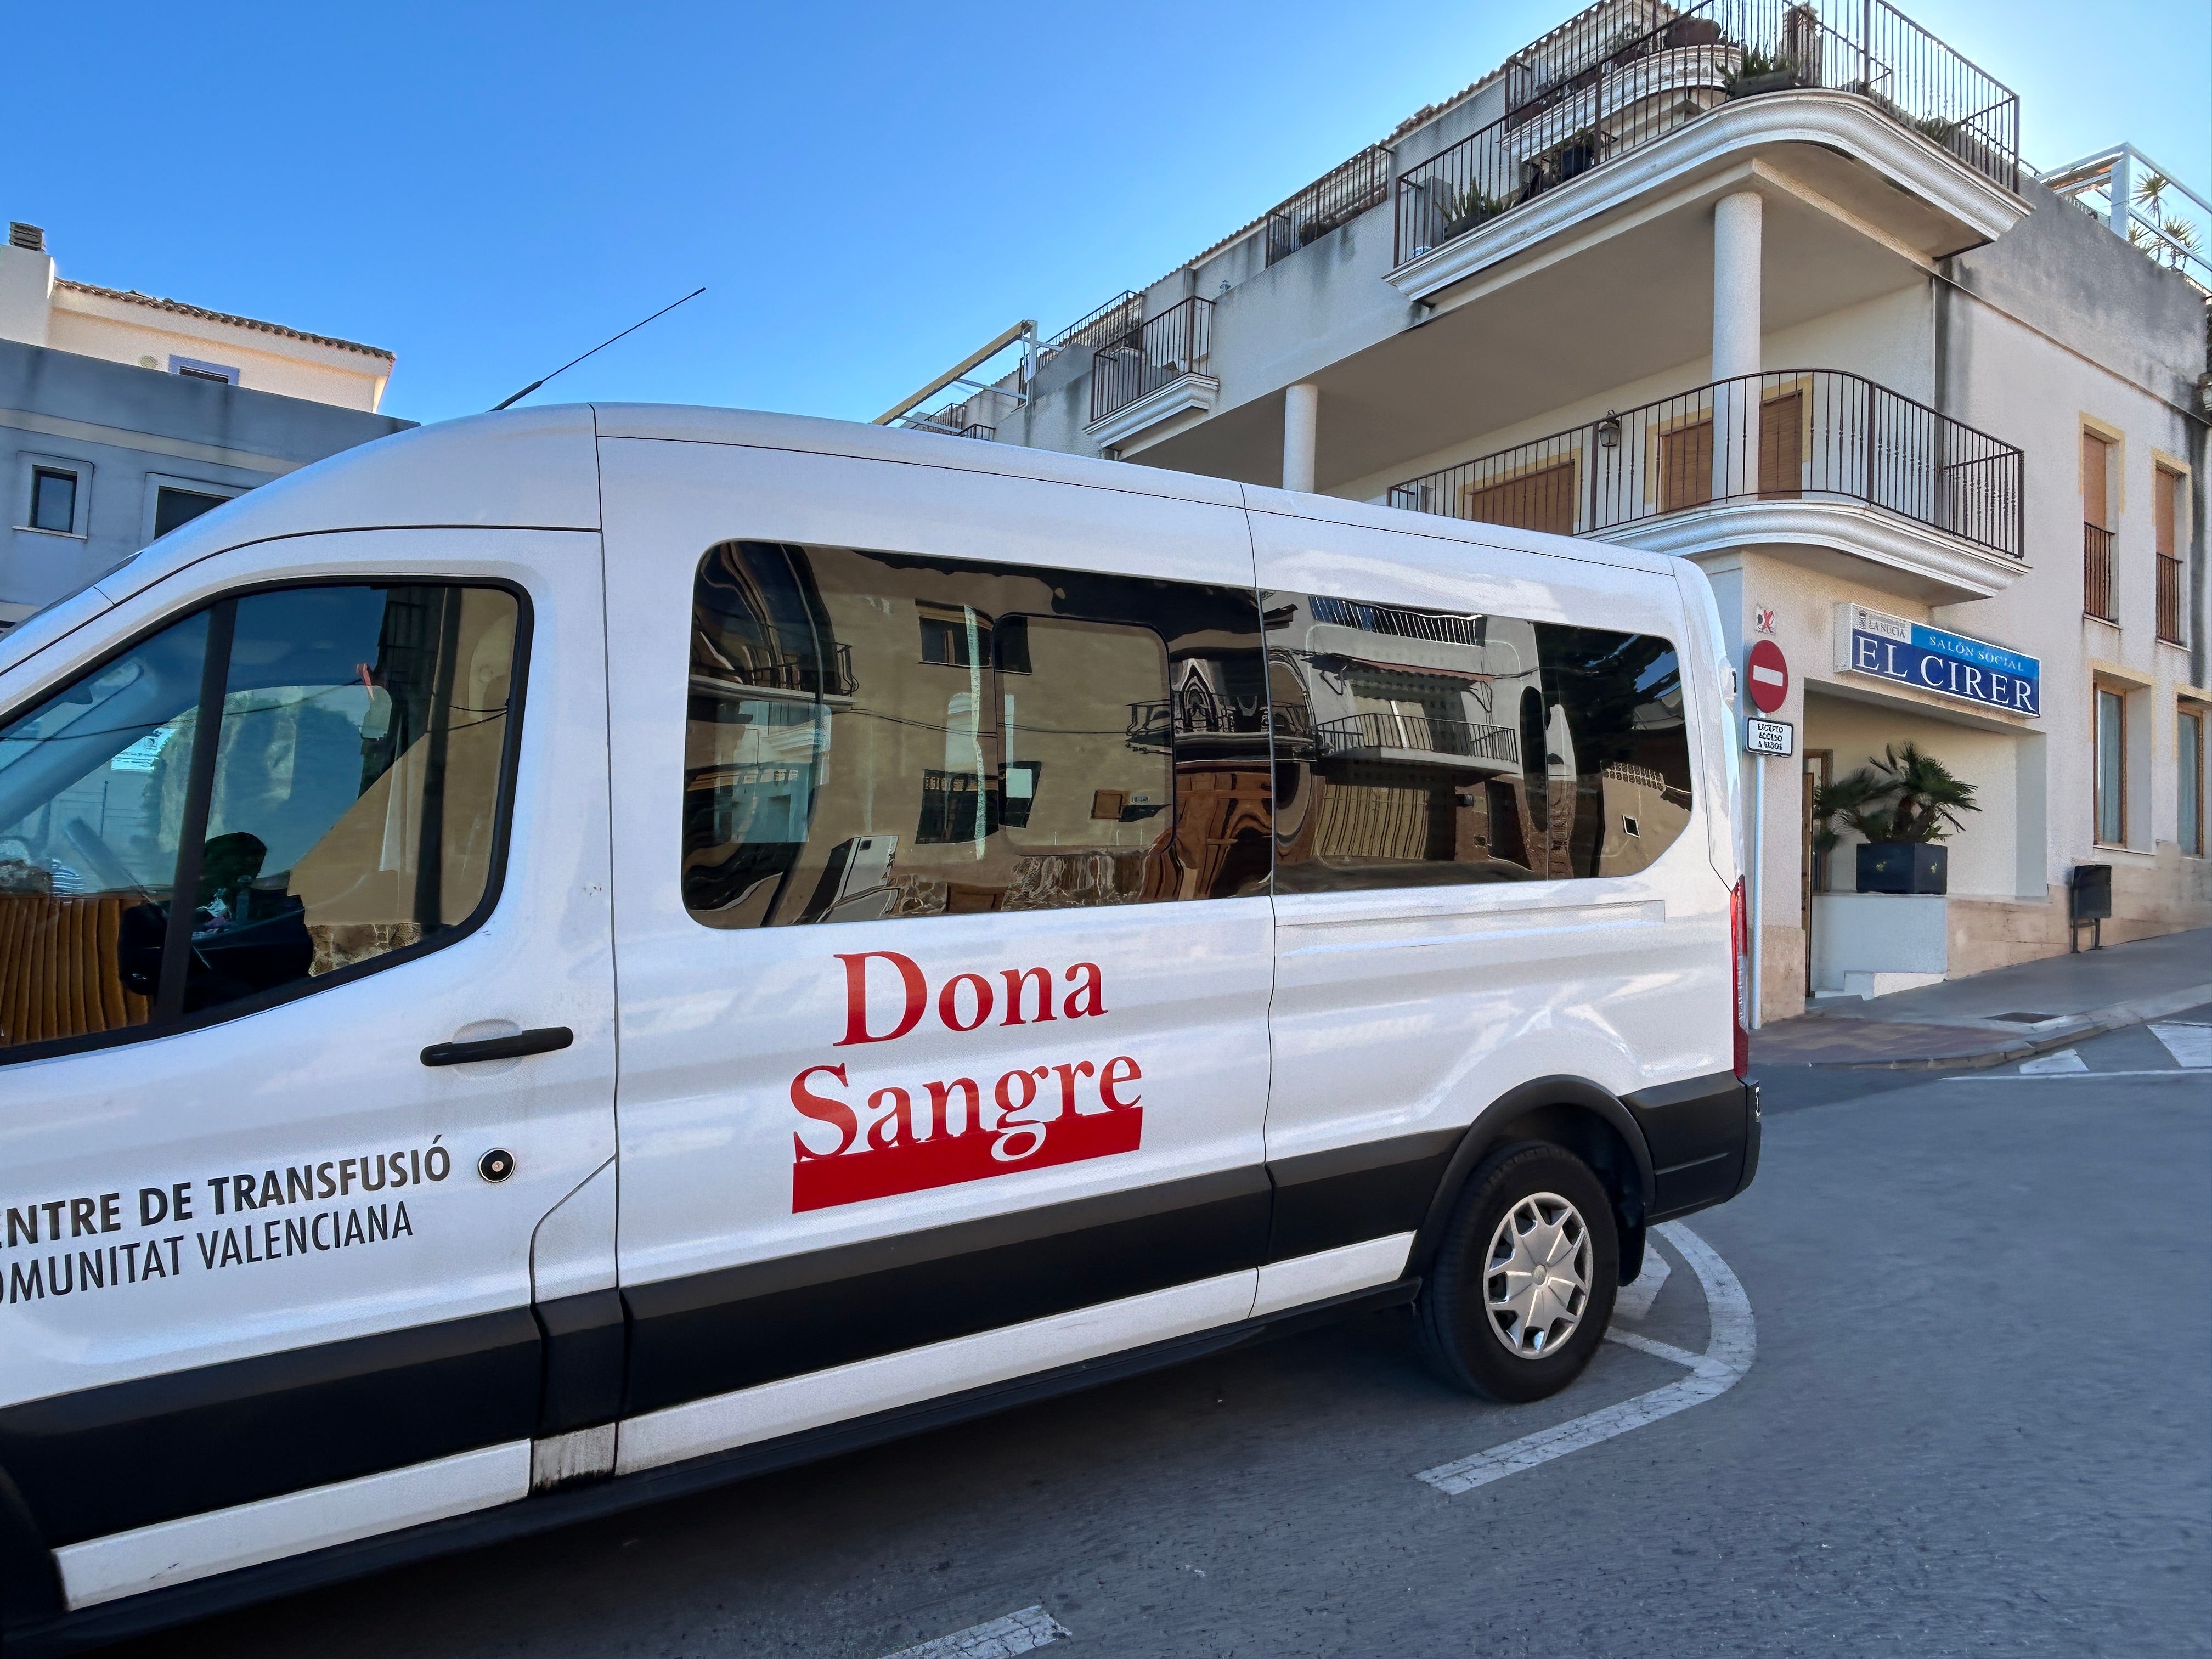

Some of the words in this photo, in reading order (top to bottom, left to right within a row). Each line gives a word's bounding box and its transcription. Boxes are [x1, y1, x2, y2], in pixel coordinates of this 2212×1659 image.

[1855, 635, 1908, 678] EL
[1920, 656, 2037, 711] CIRER
[1929, 636, 1973, 657] SALÓN
[1978, 651, 2024, 672] SOCIAL
[833, 951, 1108, 1046] Dona
[790, 1055, 1142, 1162] Sangre
[0, 1193, 121, 1249] NTRE
[139, 1182, 193, 1226] DE
[208, 1135, 450, 1215] TRANSFUSIÓ
[0, 1235, 184, 1305] MUNITAT
[197, 1201, 413, 1270] VALENCIANA
